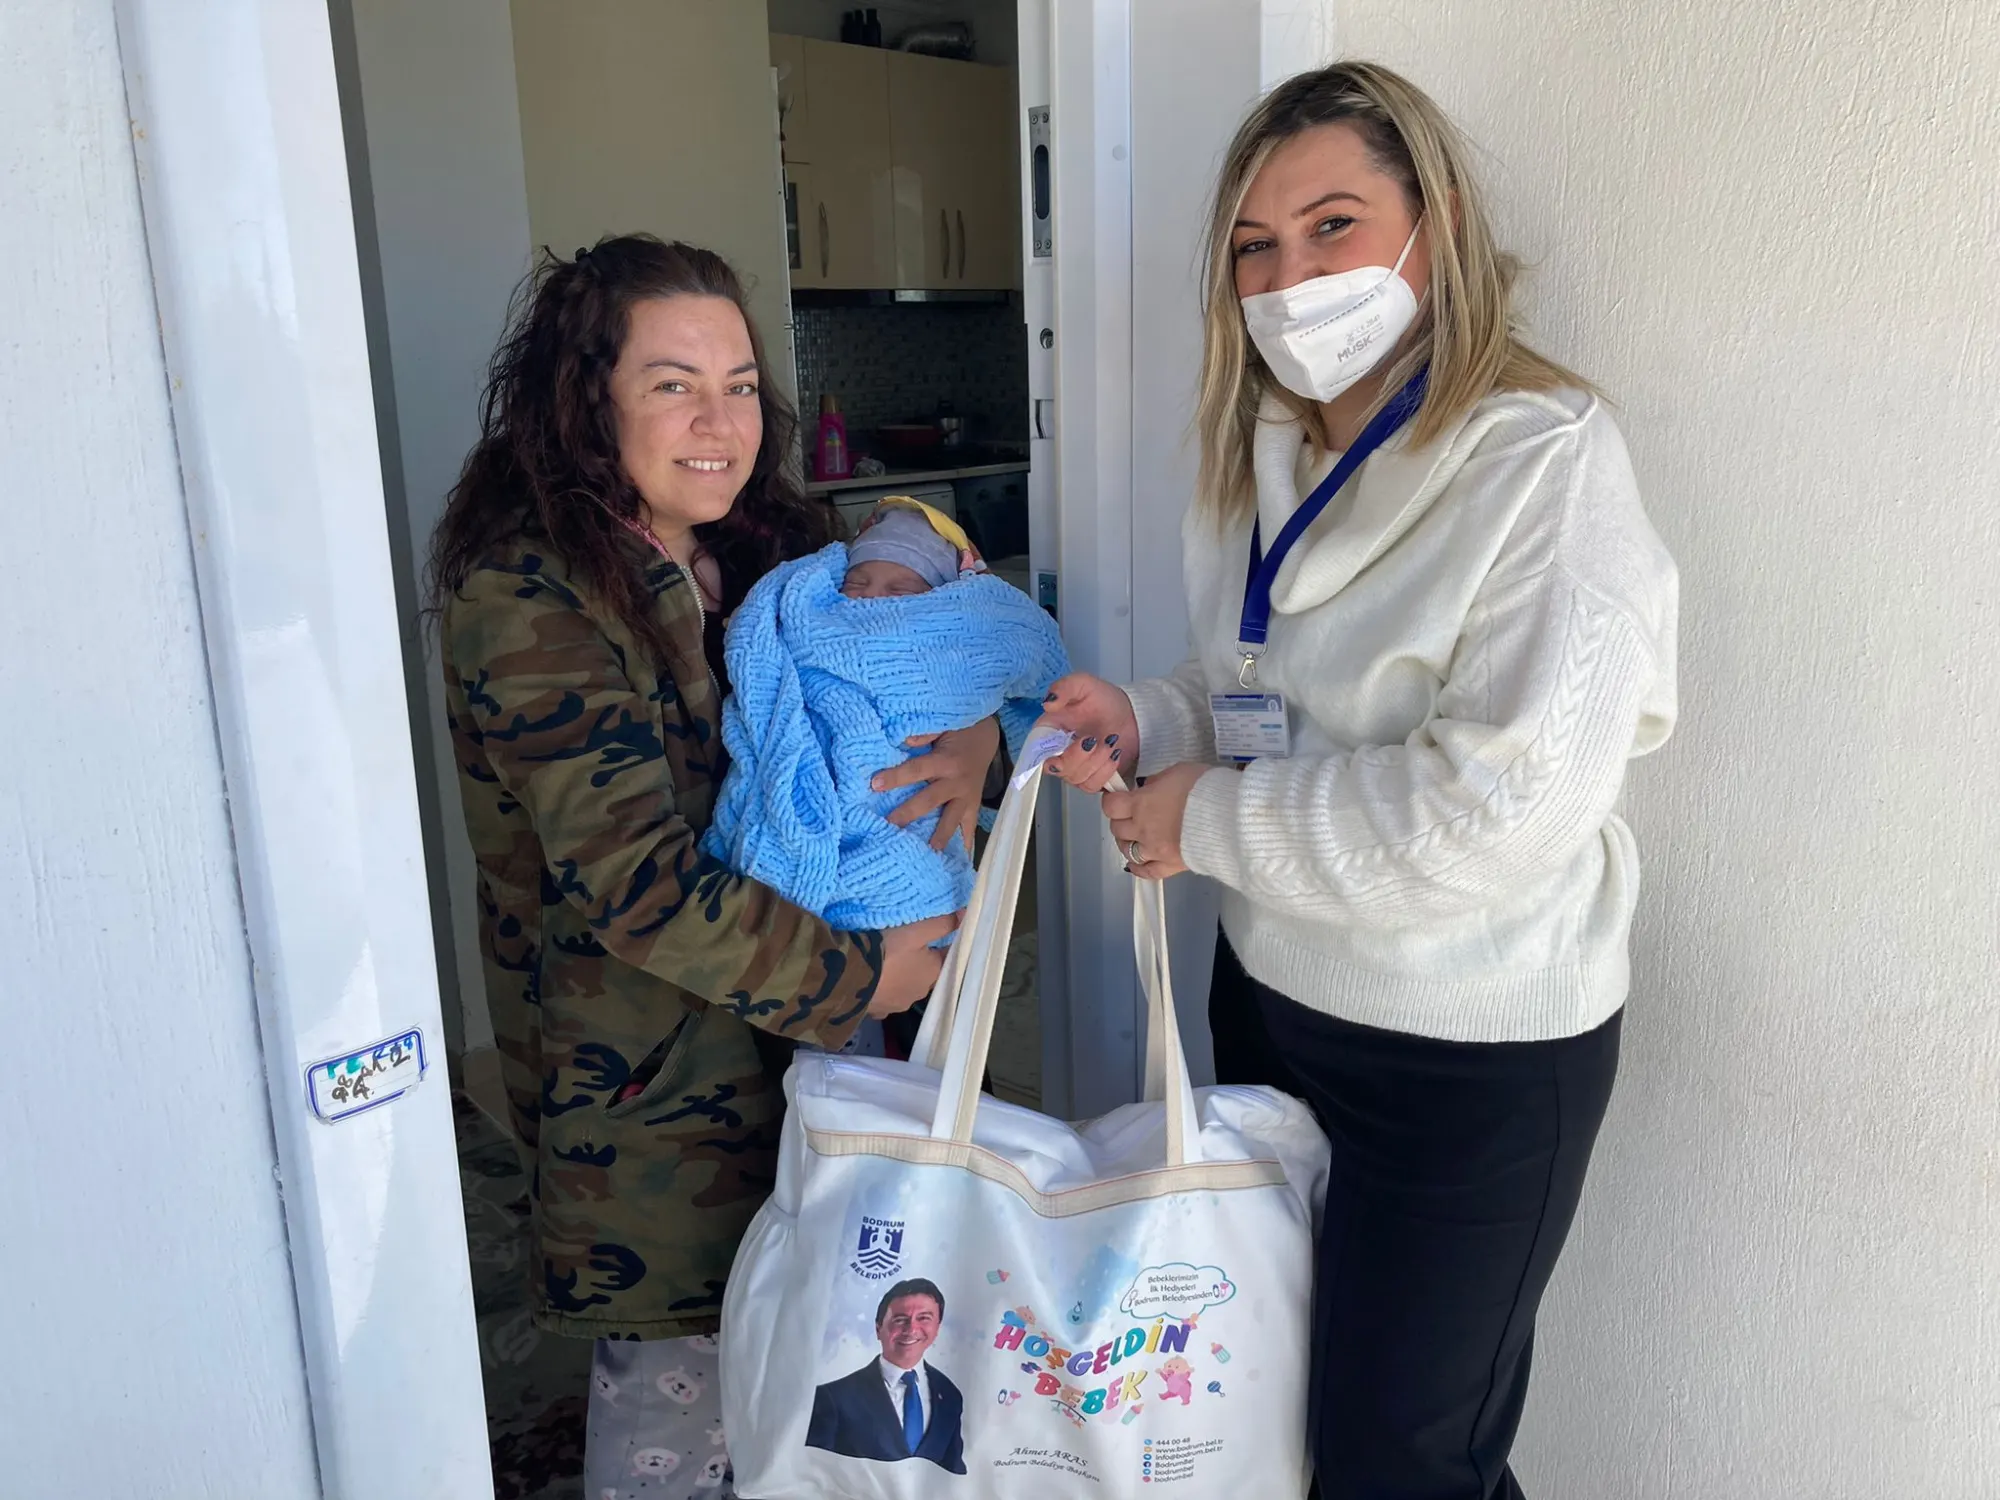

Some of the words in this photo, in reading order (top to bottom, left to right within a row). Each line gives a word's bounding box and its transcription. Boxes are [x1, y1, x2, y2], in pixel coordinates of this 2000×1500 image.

[1337, 333, 1373, 363] MUSK
[862, 1216, 905, 1228] BODRUM
[1147, 1273, 1199, 1284] Bebeklerimizin
[1160, 1284, 1197, 1294] Hediyeleri
[1134, 1295, 1160, 1306] Bodrum
[1162, 1290, 1213, 1304] Belediyesinden
[1033, 1369, 1148, 1415] BEBEK
[1155, 1439, 1224, 1453] www.bodrum.bel.tr
[1009, 1447, 1049, 1457] Ahmet
[1049, 1449, 1089, 1467] ARAS
[1155, 1446, 1223, 1461] info@bodrum.bel.tr
[993, 1459, 1028, 1468] Bodrum
[1029, 1459, 1065, 1471] Belediye
